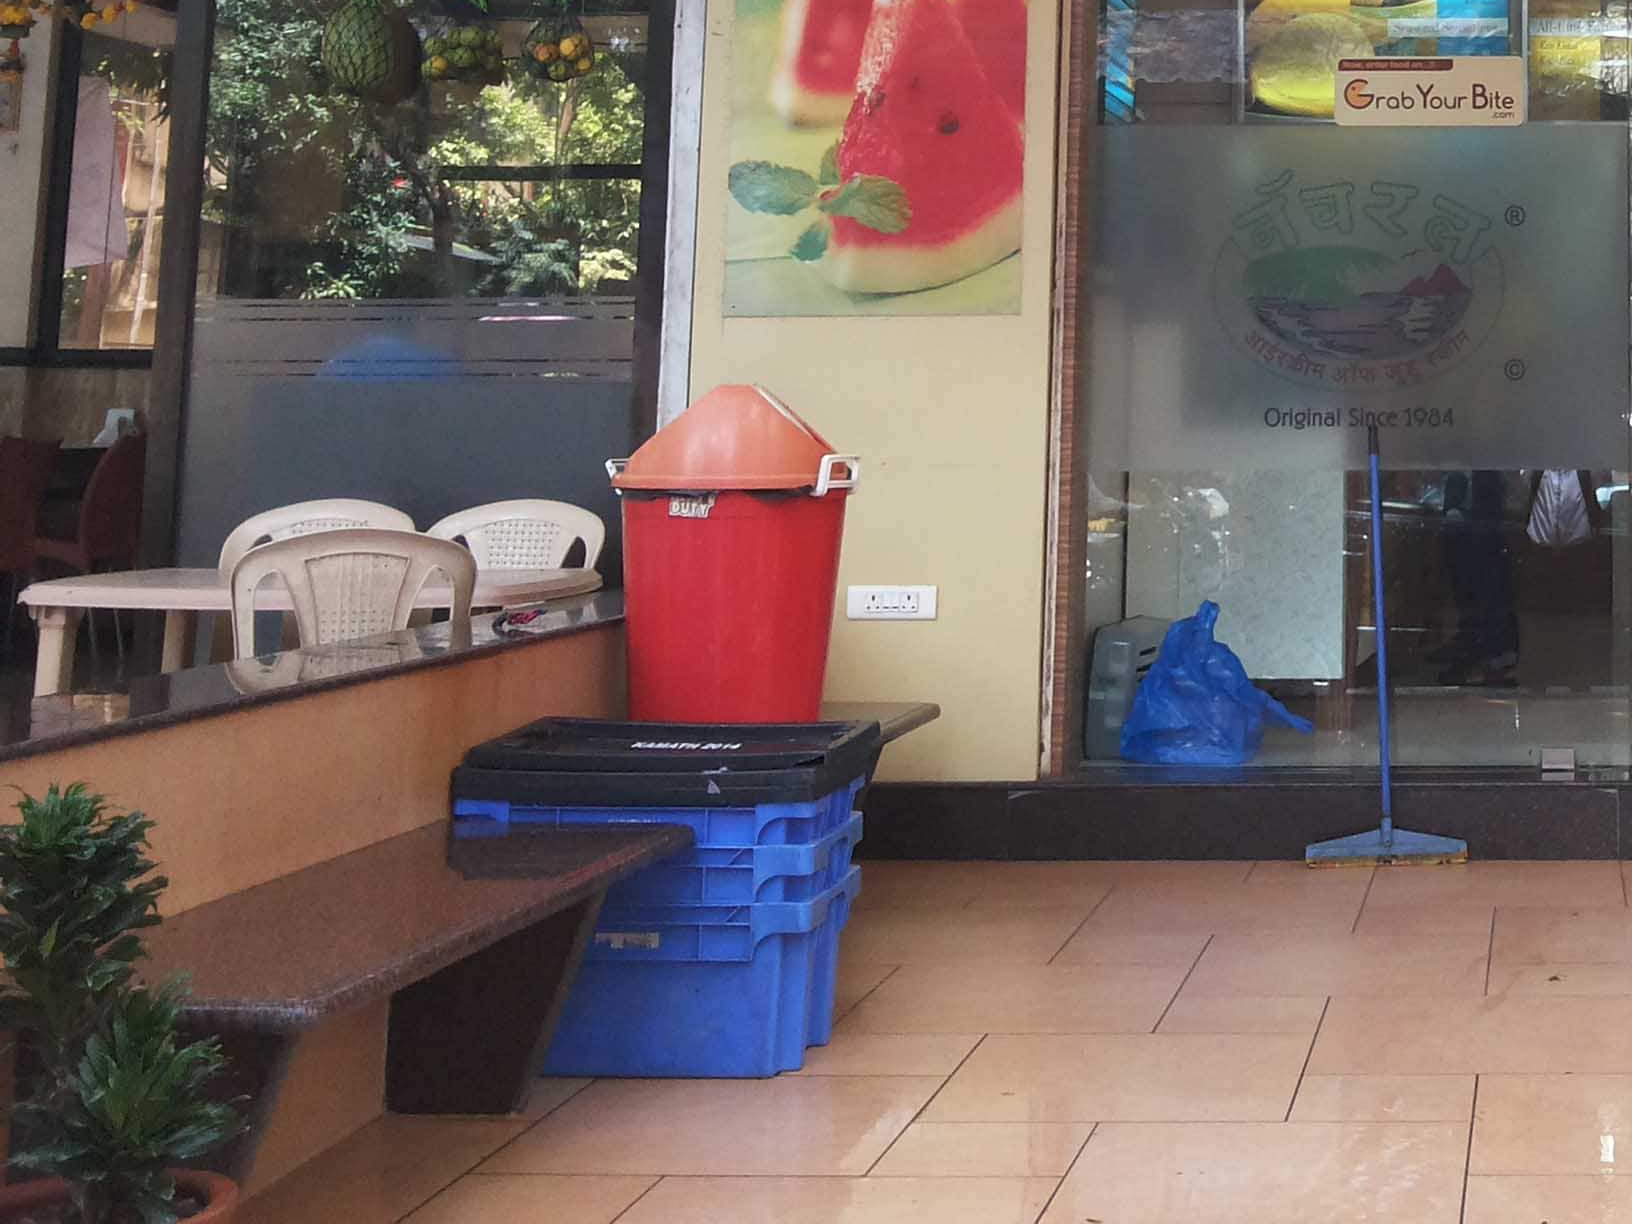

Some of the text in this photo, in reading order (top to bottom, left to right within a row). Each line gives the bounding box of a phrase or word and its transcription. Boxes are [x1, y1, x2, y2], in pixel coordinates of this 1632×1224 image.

[1416, 83, 1467, 110] Your
[1472, 83, 1515, 110] Bite
[1264, 407, 1455, 430] Original Since 1984
